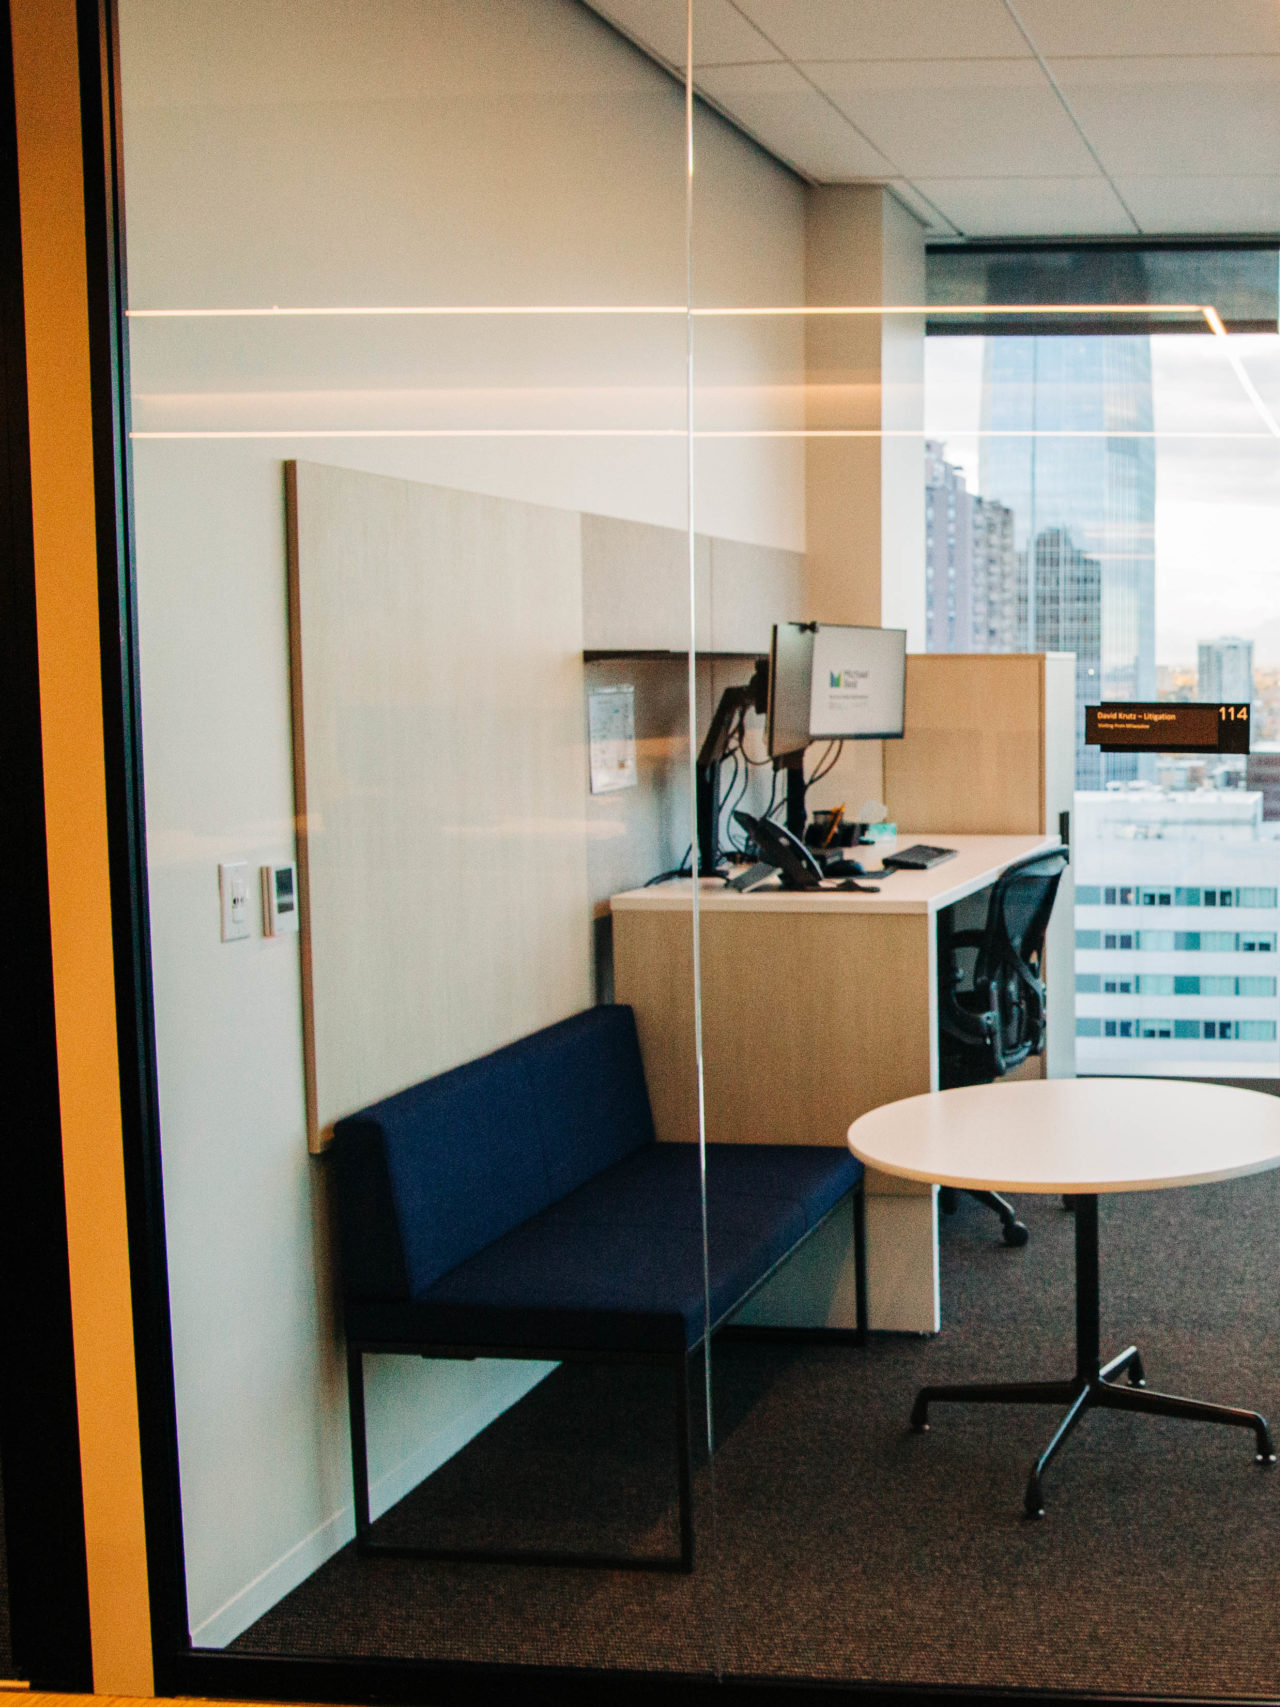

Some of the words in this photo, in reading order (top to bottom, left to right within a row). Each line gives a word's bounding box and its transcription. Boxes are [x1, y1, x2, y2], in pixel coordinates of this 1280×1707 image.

[1097, 711, 1117, 720] David
[1118, 712, 1137, 720] Krutz
[1143, 712, 1177, 722] Litigation
[1219, 706, 1248, 720] 114
